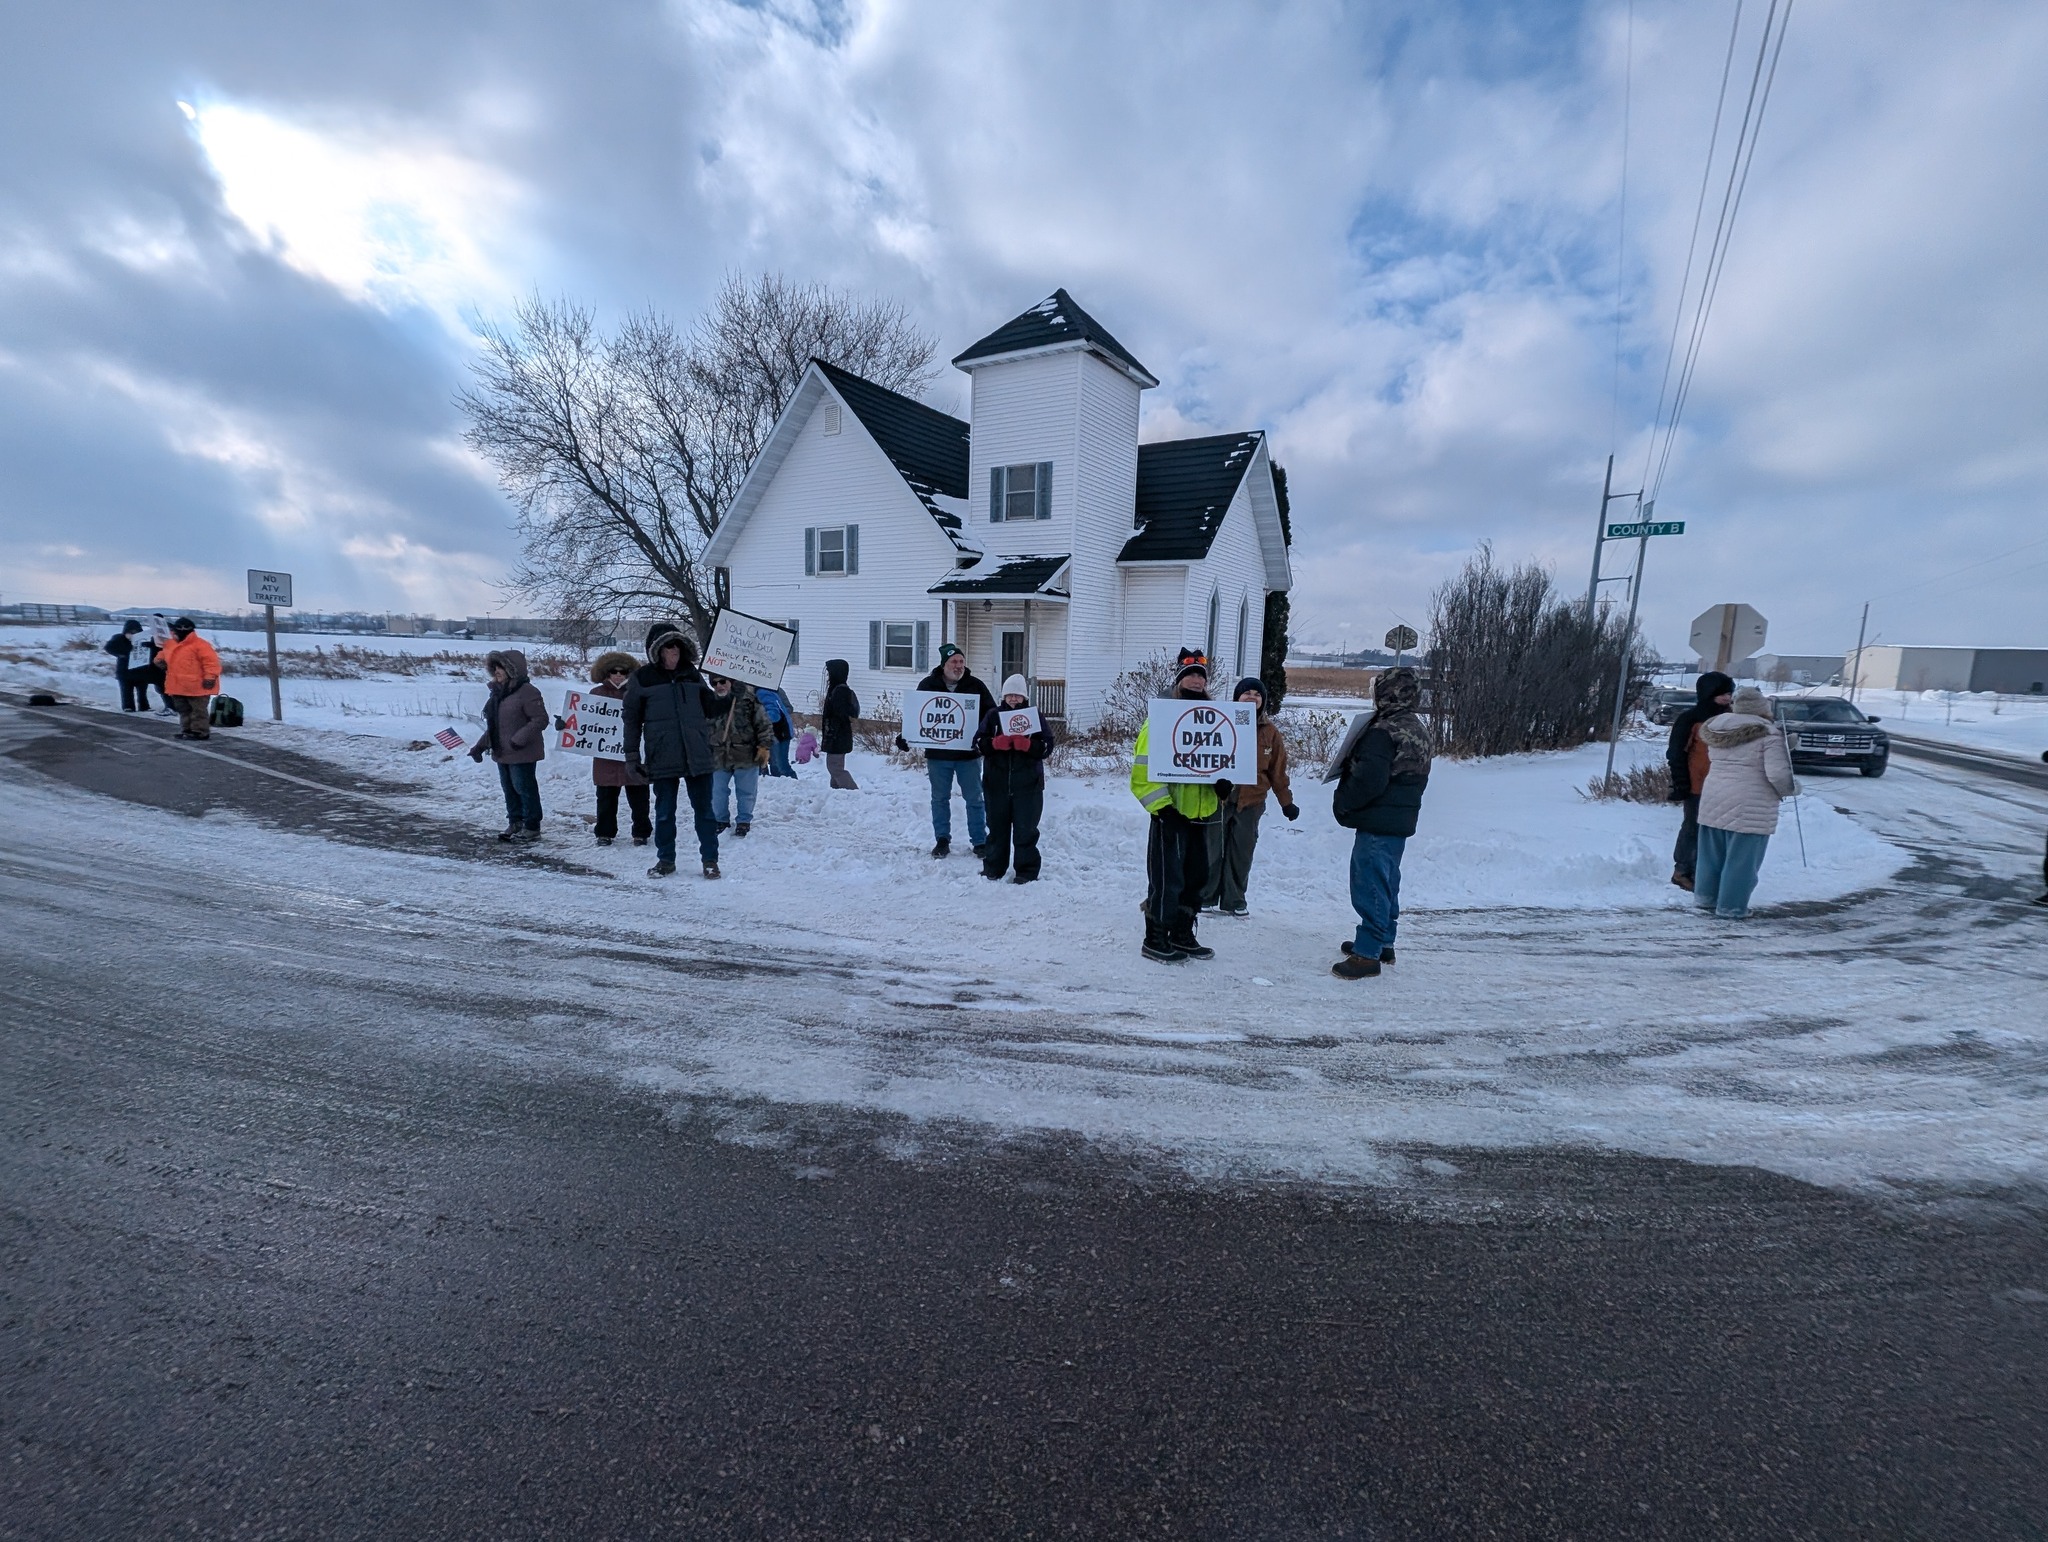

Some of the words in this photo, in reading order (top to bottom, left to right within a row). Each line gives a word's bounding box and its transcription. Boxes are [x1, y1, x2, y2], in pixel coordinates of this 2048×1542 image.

[1612, 524, 1665, 535] COUNTY
[1670, 523, 1680, 533] B
[263, 575, 277, 583] NO
[261, 584, 279, 592] ATV
[255, 592, 287, 602] TRAFFIC
[729, 635, 754, 649] DRINK
[756, 643, 775, 656] DATA
[715, 647, 740, 660] FAMILY
[706, 656, 726, 667] NOT
[729, 662, 745, 673] DATA
[748, 666, 772, 679] FARMS
[935, 698, 952, 709] NO
[926, 713, 955, 724] DATA
[1193, 709, 1216, 725] NO
[564, 713, 618, 736] Against
[920, 727, 964, 740] CENTER!
[1182, 731, 1223, 747] DATA
[561, 732, 593, 749] Data
[1173, 753, 1236, 769] CENTER!
